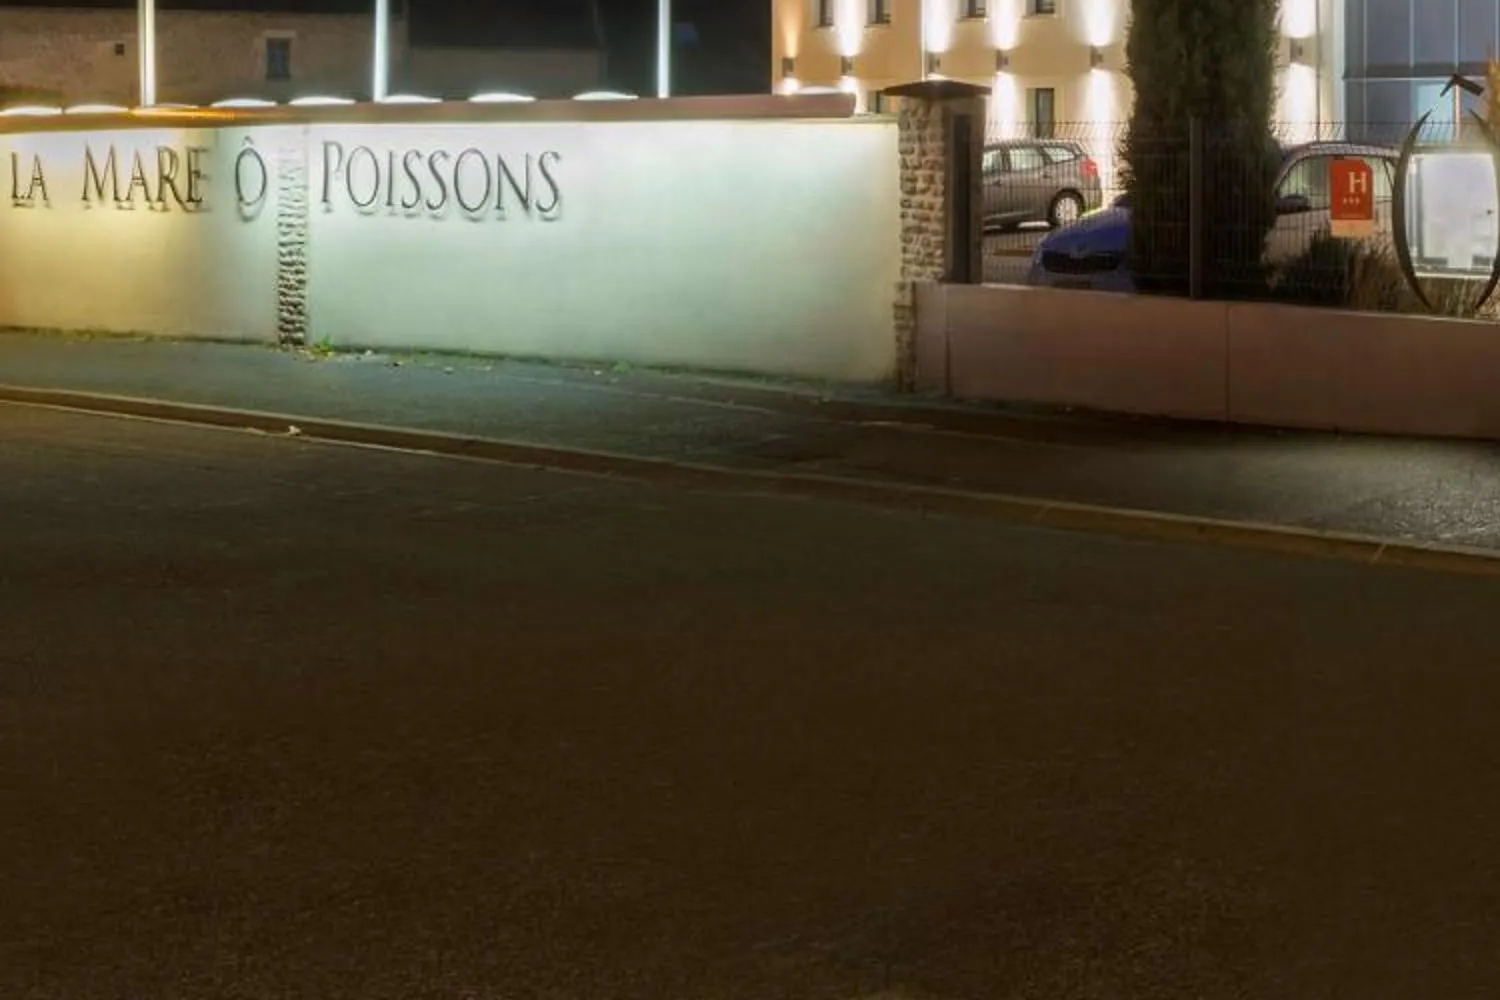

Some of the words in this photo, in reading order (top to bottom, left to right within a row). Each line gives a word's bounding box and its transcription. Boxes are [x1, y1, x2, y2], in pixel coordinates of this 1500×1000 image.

[10, 150, 48, 203] LA
[82, 143, 208, 206] MARE
[234, 136, 268, 207] Ô
[320, 140, 562, 214] POISSONS
[1348, 171, 1366, 194] H
